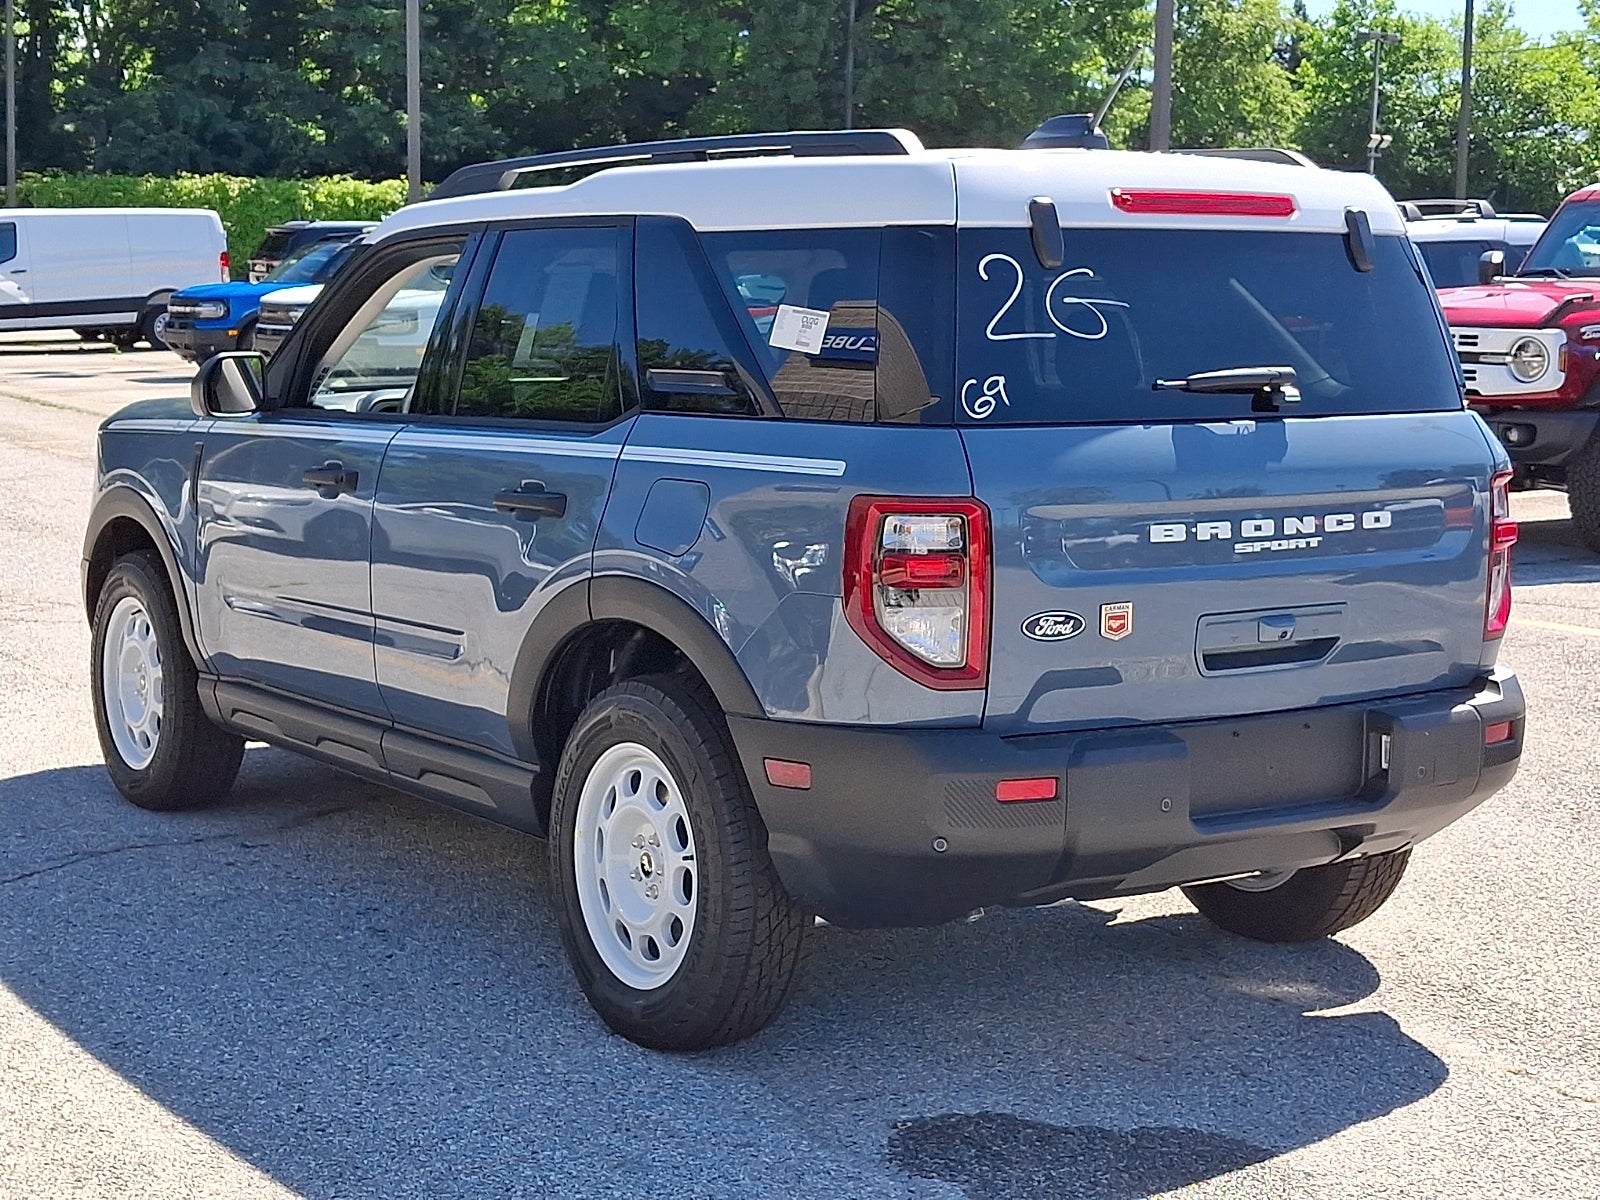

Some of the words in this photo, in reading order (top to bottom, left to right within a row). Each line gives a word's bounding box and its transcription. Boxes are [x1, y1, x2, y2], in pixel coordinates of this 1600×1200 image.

[962, 374, 1010, 419] 69
[1149, 510, 1392, 543] BRONCO
[1233, 536, 1323, 554] SPORT
[1104, 604, 1130, 612] CARMAN
[1034, 616, 1075, 635] Ford
